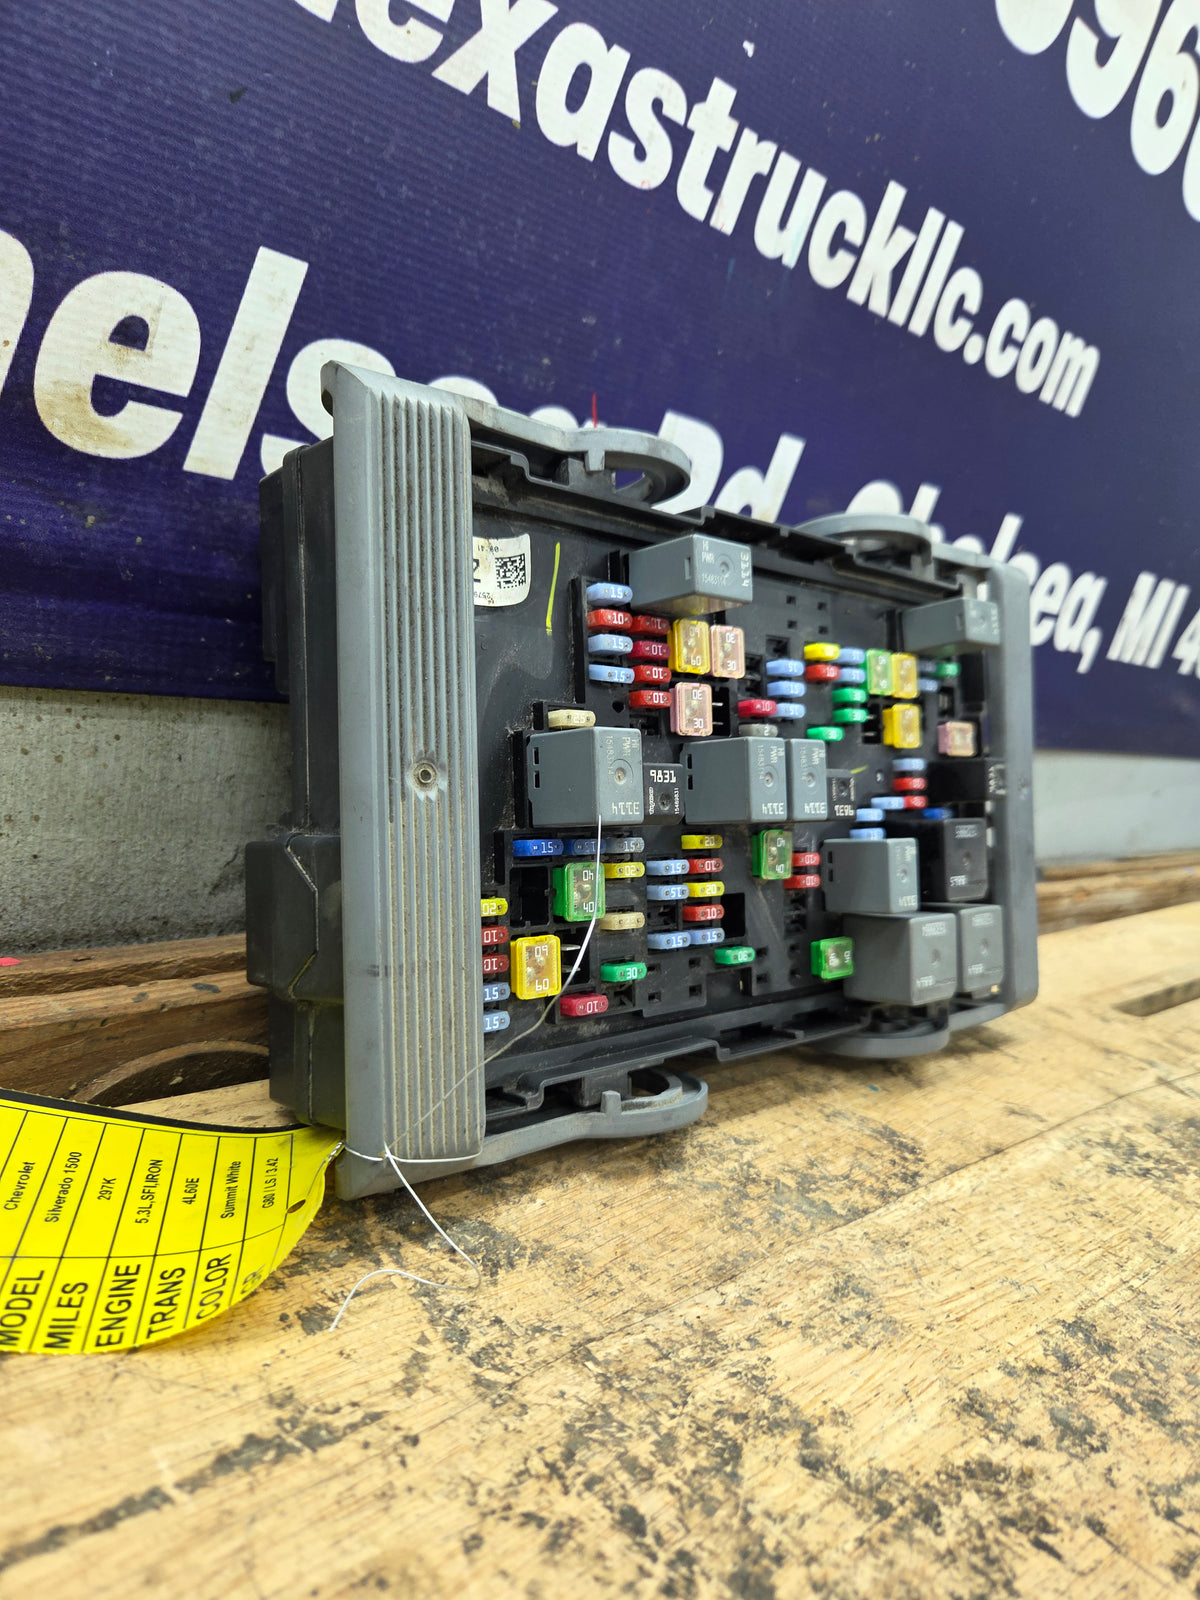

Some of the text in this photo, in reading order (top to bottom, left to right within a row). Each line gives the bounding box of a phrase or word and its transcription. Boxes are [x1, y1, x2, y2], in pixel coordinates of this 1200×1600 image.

[294, 0, 1100, 417] exastruckllc.com
[610, 586, 623, 598] 15
[612, 612, 624, 624] 10
[1106, 570, 1190, 669] MI
[612, 636, 624, 650] 15
[725, 632, 736, 644] 30
[651, 644, 663, 656] 10
[727, 660, 737, 671] 30
[613, 669, 626, 682] 15
[652, 667, 664, 679] 10
[653, 692, 665, 704] 10
[692, 689, 702, 700] 30
[693, 717, 704, 729] 30
[649, 769, 677, 783] 9831
[611, 801, 640, 815] 3114
[762, 803, 785, 815] 3114
[540, 841, 554, 854] 15
[623, 840, 636, 852] 15
[704, 836, 715, 847] 20
[624, 865, 636, 876] 20
[670, 862, 681, 873] 15
[704, 860, 716, 871] 10
[582, 870, 594, 881] 40
[670, 887, 682, 898] 15
[705, 884, 717, 895] 20
[482, 902, 497, 915] 20
[706, 908, 717, 919] 10
[483, 930, 498, 943] 10
[671, 935, 683, 947] 15
[706, 931, 718, 942] 15
[534, 945, 549, 957] 60
[483, 958, 498, 971] 10
[625, 967, 638, 979] 30
[535, 979, 550, 991] 60
[484, 986, 499, 1000] 15
[586, 1001, 599, 1013] 10
[485, 1016, 499, 1030] 15
[265, 1157, 279, 1173] 3.42
[3, 1161, 36, 1211] Chevrolet
[44, 1151, 82, 1223] Silverado 1500
[97, 1178, 117, 1200] 297K
[182, 1177, 200, 1205] 4L60E
[220, 1161, 241, 1219] Summit White
[196, 1253, 232, 1321] COLOR
[0, 1270, 45, 1346] MODEL
[95, 1264, 141, 1348] ENGINE
[146, 1267, 186, 1340] TRANS
[43, 1282, 89, 1349] MILES
